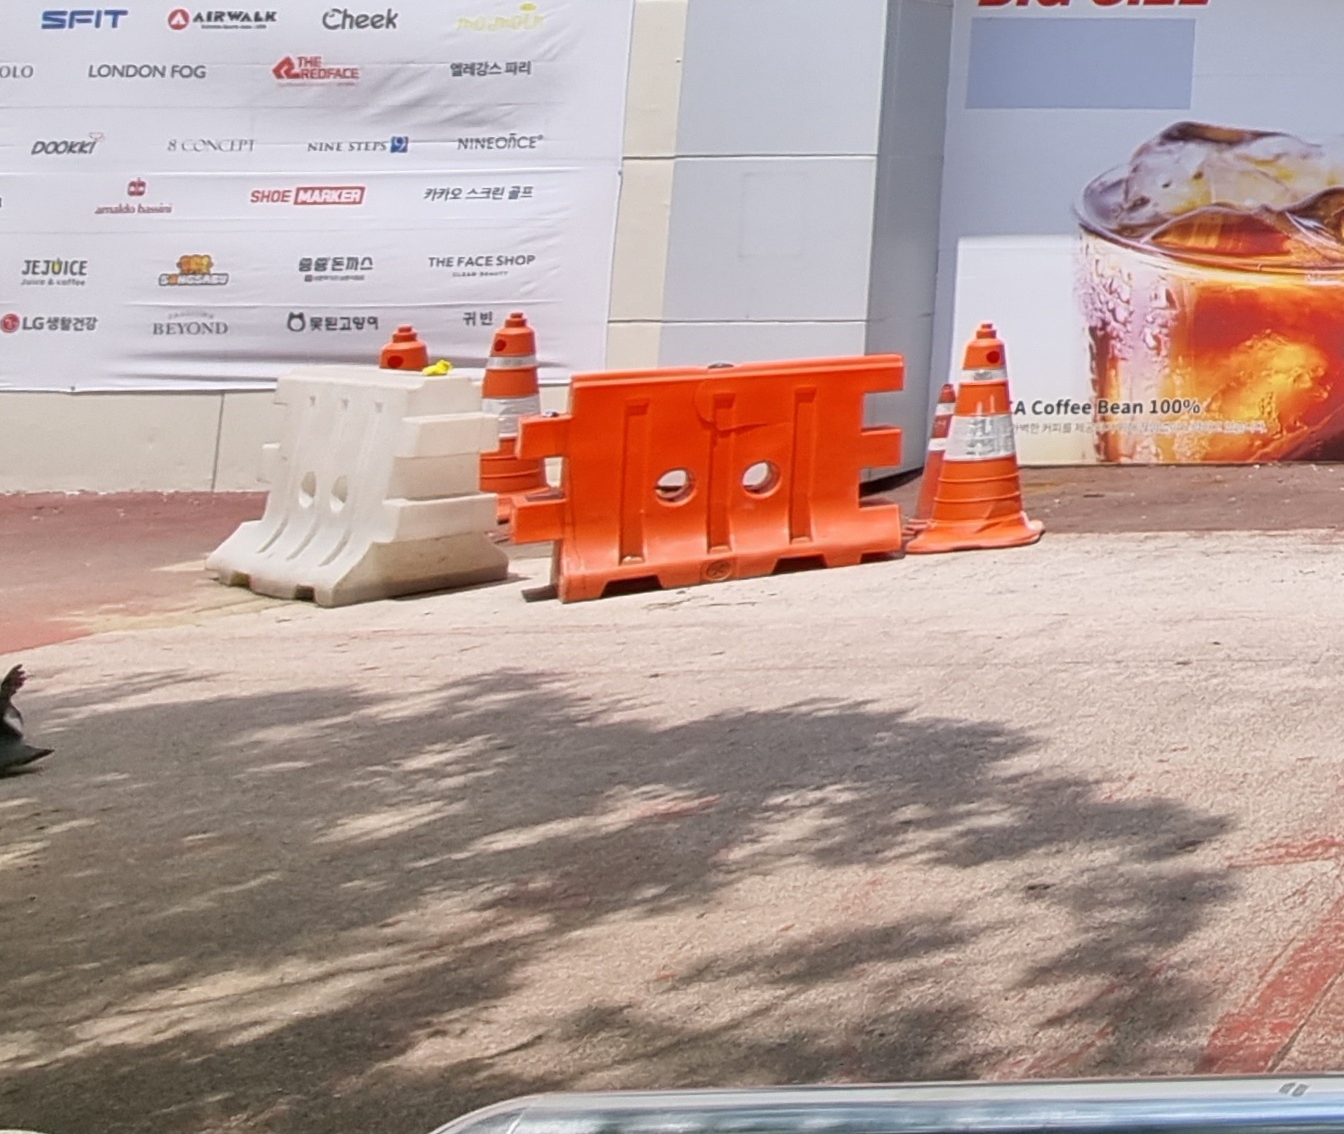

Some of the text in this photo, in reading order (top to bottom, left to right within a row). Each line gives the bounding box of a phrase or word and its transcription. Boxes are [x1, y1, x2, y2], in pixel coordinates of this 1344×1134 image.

[41, 9, 128, 30] SFIT
[193, 11, 278, 23] AIRWALK
[321, 8, 399, 31] Cheek
[297, 56, 322, 67] THE
[504, 61, 532, 76] 파리
[88, 64, 207, 79] LONDON FOG
[301, 67, 360, 80] REDFACE
[181, 139, 256, 153] CONCEPT
[307, 142, 342, 153] NINE
[348, 141, 388, 152] STEPS
[250, 187, 361, 204] SHOE MARKER
[424, 185, 534, 201] 카카오 스크린 골프
[21, 259, 88, 276] JEJUICE
[428, 254, 536, 268] THE FACE SHOP
[153, 321, 228, 335] BEYOND
[1031, 398, 1092, 416] Coffee
[1097, 399, 1143, 415] Bean
[1149, 398, 1200, 415] 100%
